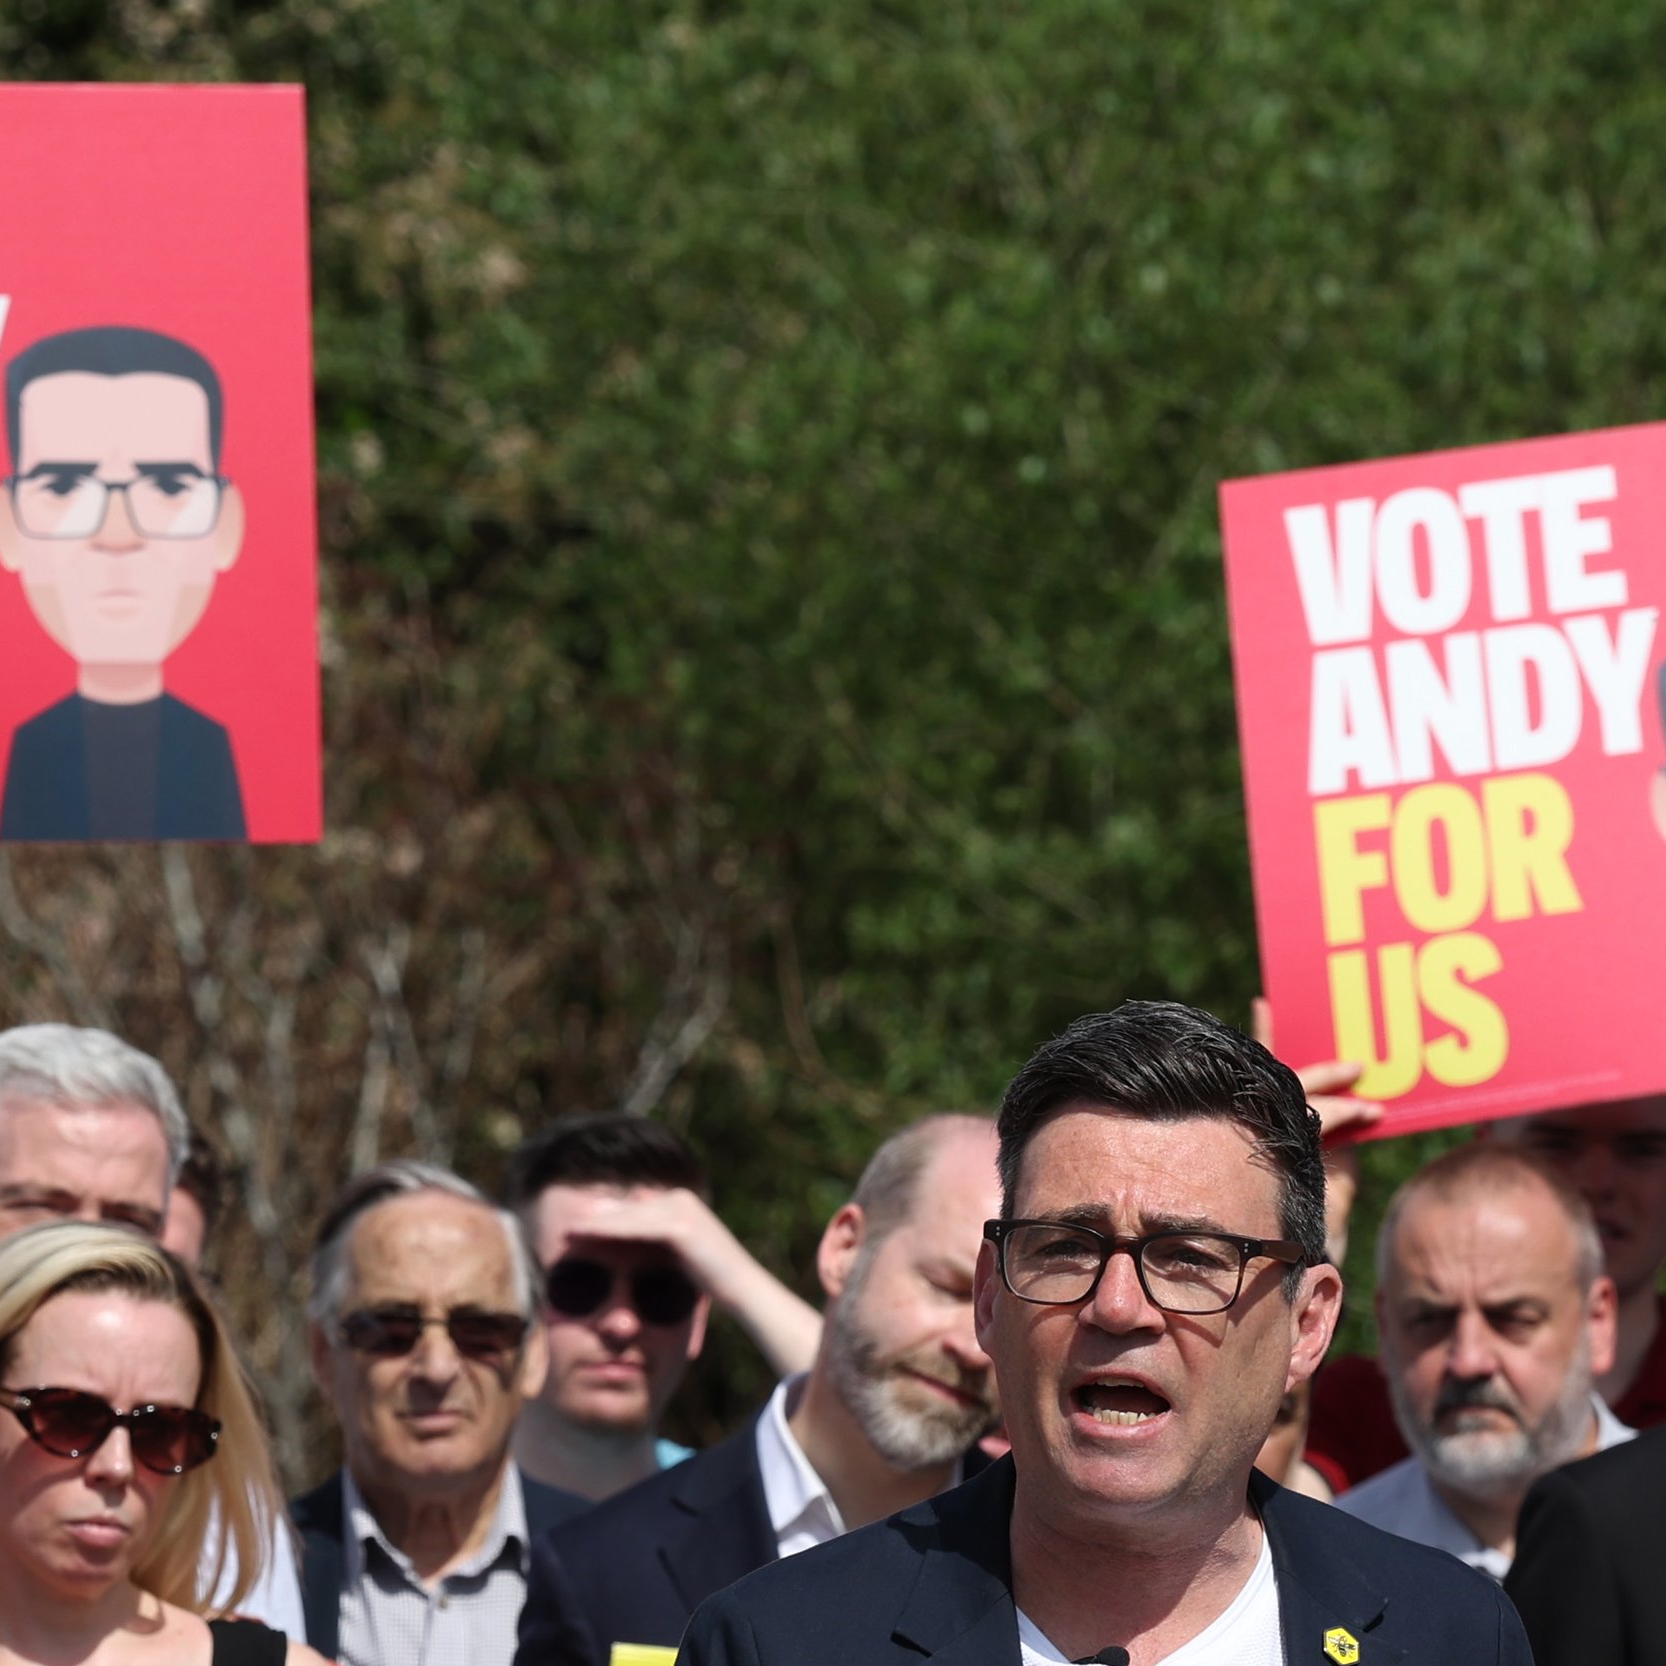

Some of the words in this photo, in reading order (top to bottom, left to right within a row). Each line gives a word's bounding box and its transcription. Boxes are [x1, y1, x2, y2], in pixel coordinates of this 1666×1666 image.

[1284, 465, 1628, 645] VOTE
[1309, 607, 1659, 795] ANDY
[1314, 773, 1582, 946] FOR
[1326, 931, 1510, 1099] US
